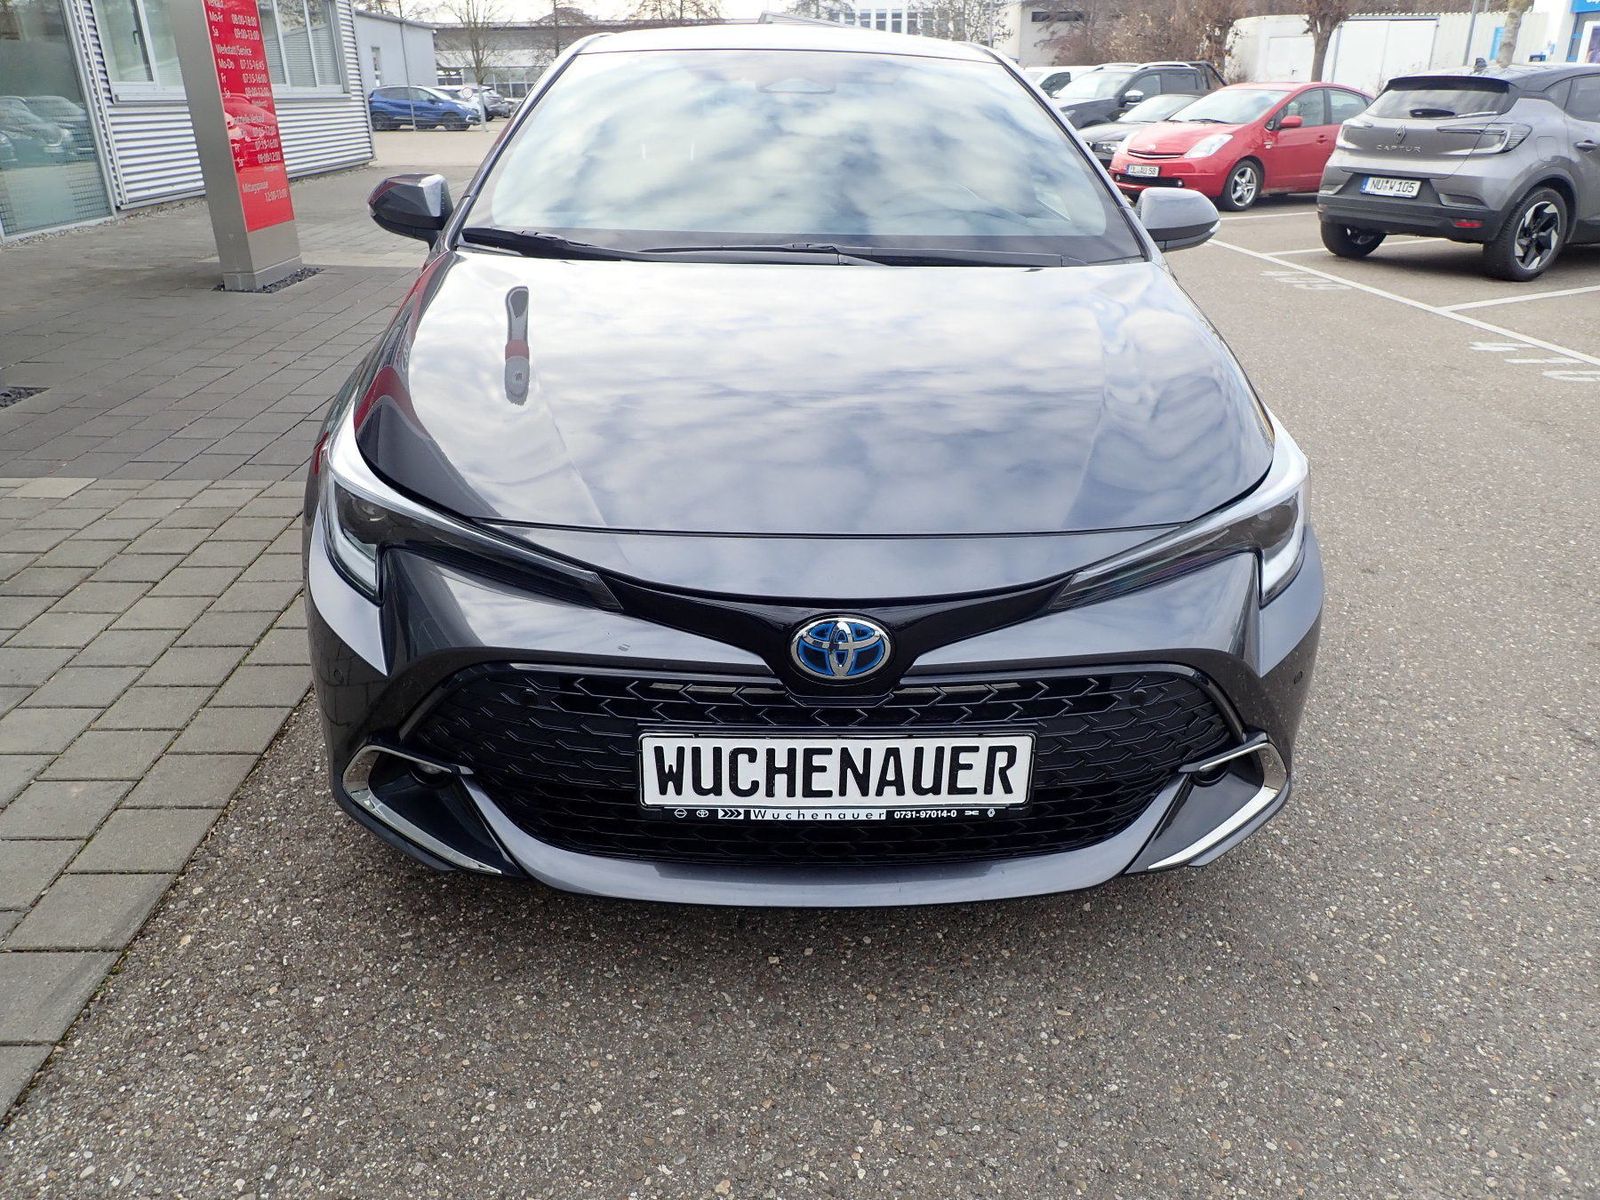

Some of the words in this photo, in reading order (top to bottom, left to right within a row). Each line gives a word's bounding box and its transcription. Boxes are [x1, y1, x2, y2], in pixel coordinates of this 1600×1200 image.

[1376, 144, 1423, 153] CAPTUR
[1396, 181, 1416, 193] 105
[654, 746, 1018, 797] WUCHENAUER
[752, 809, 885, 820] Wuchenauer
[894, 810, 958, 820] 0731-97014-0
